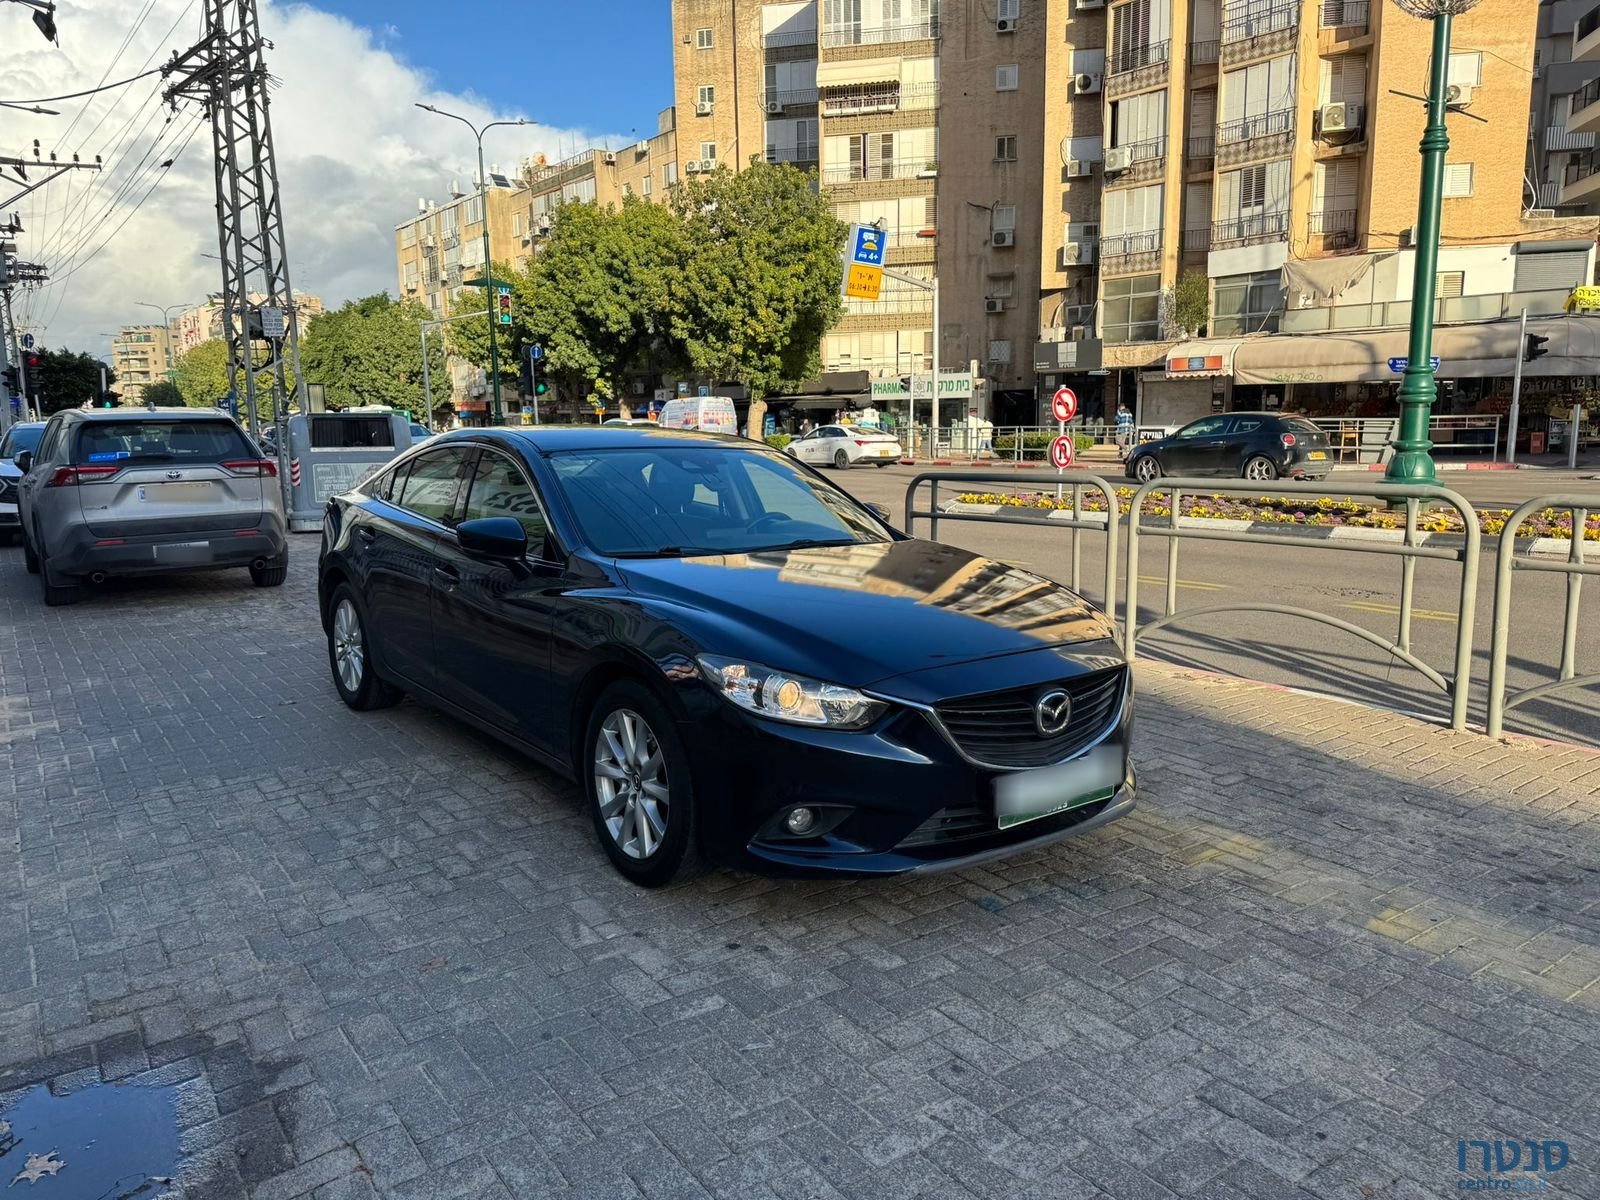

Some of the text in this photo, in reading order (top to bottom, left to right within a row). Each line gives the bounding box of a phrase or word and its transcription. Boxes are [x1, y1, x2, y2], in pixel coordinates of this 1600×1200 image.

[868, 252, 879, 261] 4+
[873, 381, 910, 395] PHARMA
[927, 379, 970, 396] בית מרקת
